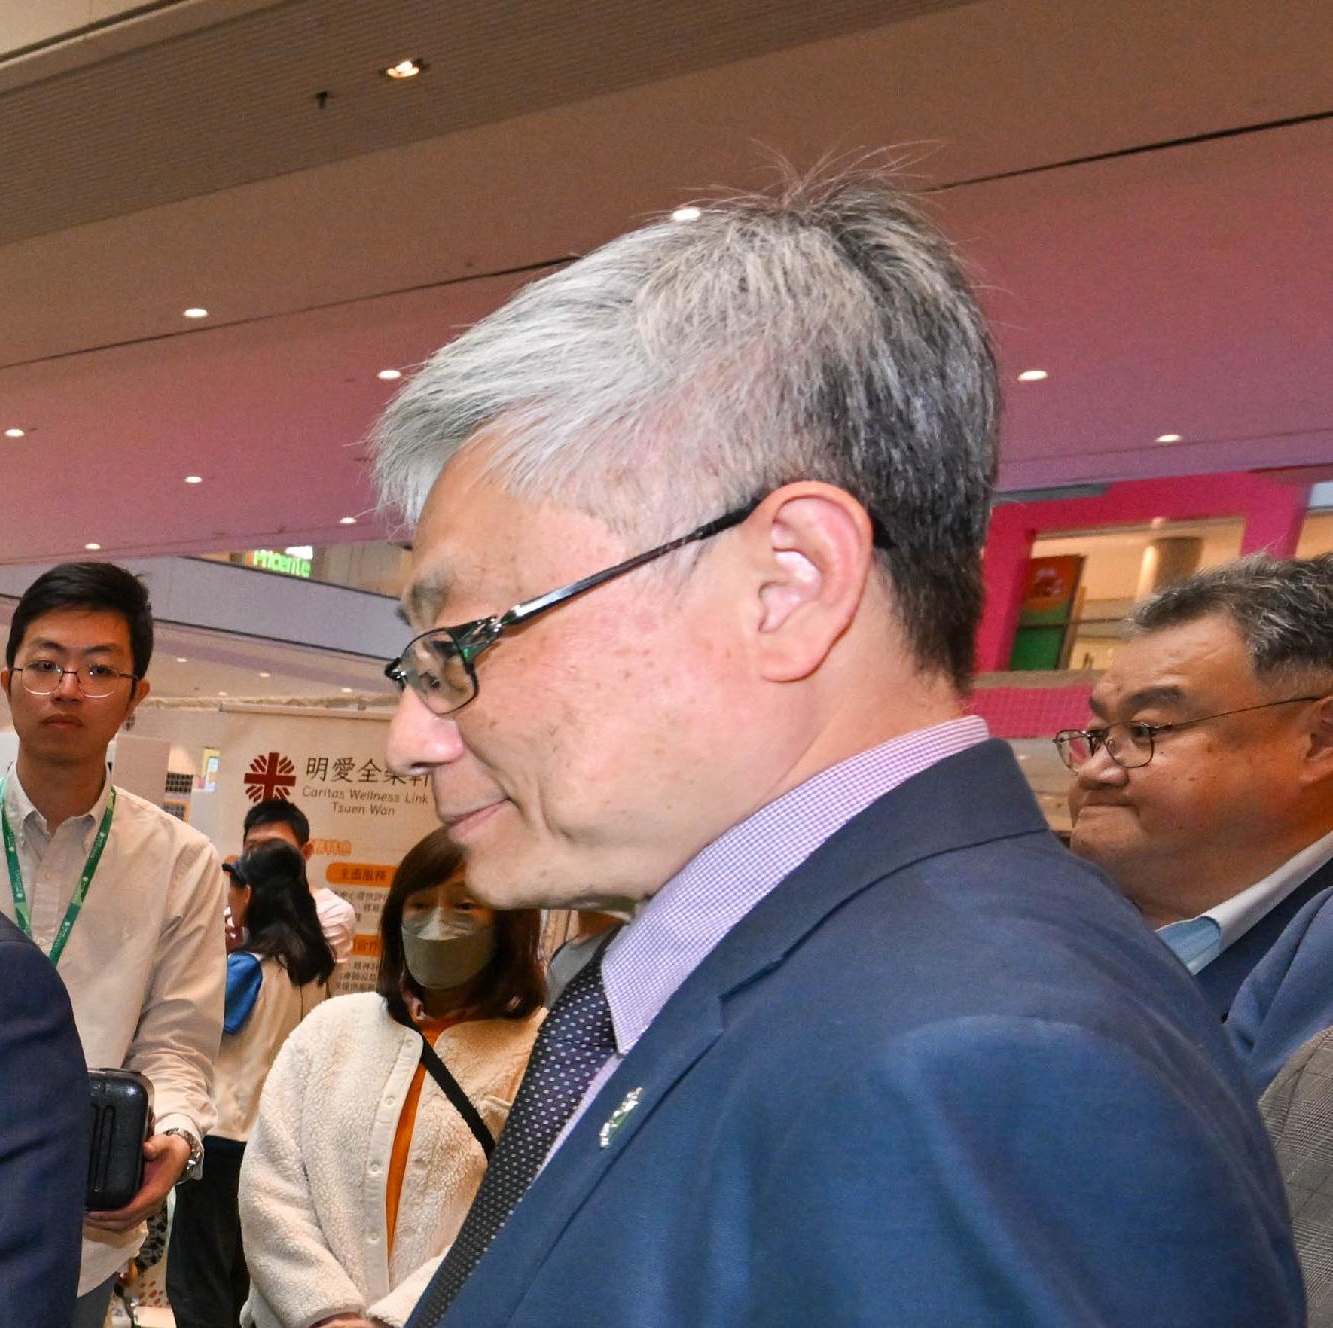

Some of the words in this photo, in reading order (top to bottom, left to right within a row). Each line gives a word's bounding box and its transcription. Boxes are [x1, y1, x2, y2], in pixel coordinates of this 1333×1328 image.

[302, 785, 345, 800] Caritas
[349, 790, 400, 804] Wellness
[405, 792, 429, 805] Link
[332, 802, 365, 815] Tsuen
[369, 803, 395, 816] Wan
